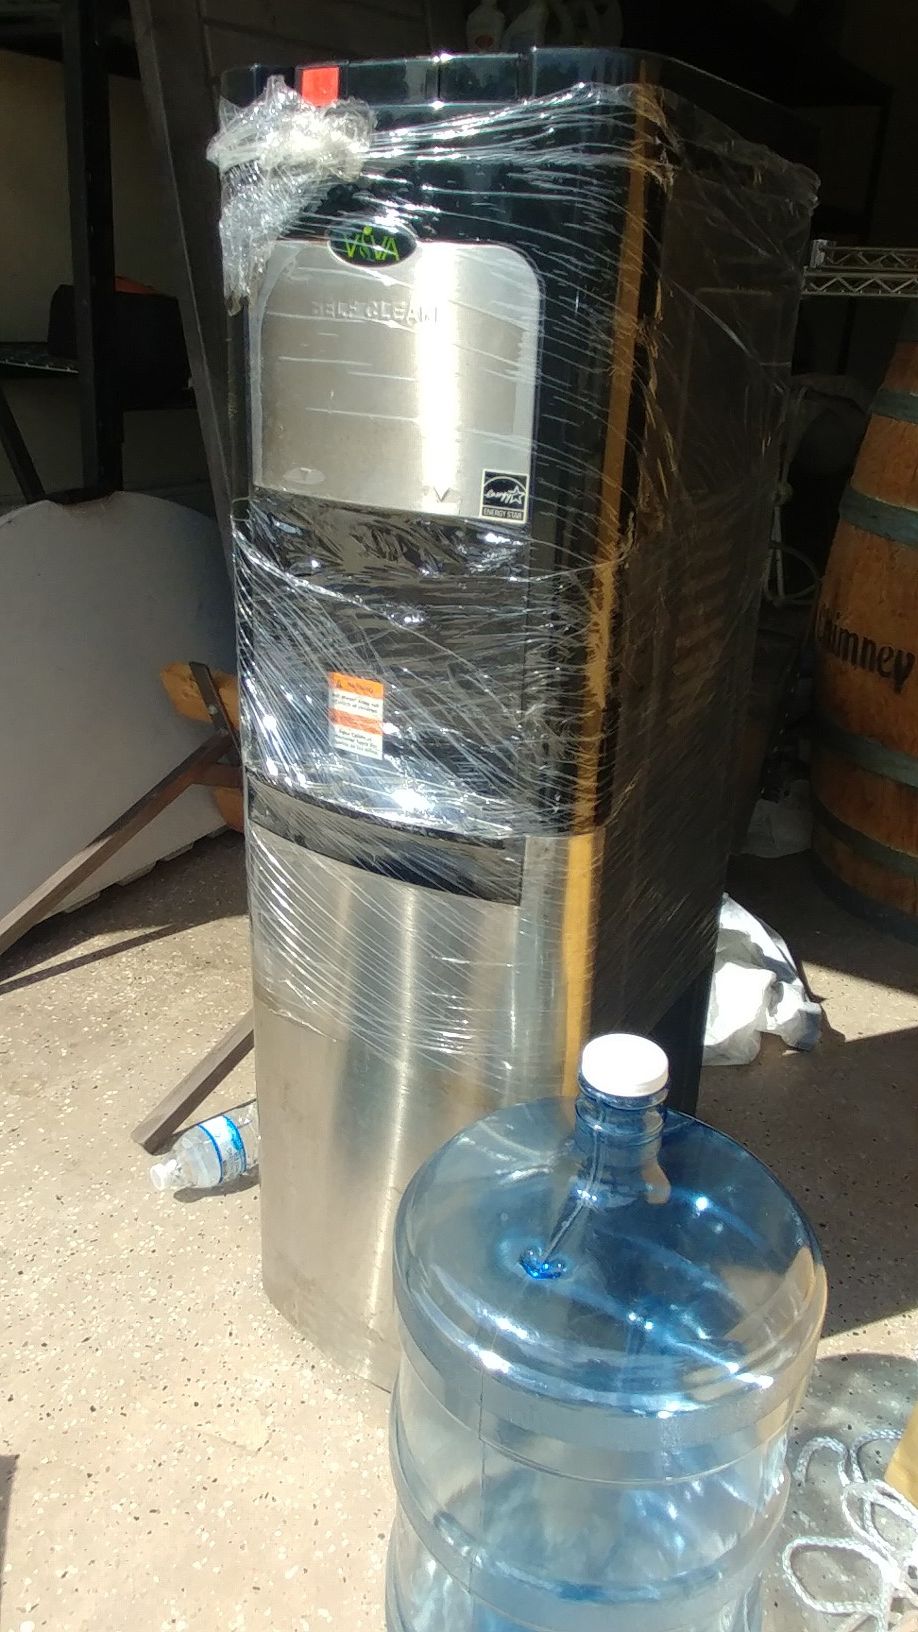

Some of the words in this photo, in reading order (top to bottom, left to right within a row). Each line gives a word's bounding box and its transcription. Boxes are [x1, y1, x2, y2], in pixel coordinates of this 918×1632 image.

[343, 225, 400, 262] VIVA
[311, 300, 357, 319] SELF
[366, 301, 438, 324] CLEAN
[484, 508, 506, 518] ENERGY
[507, 511, 522, 519] STAR
